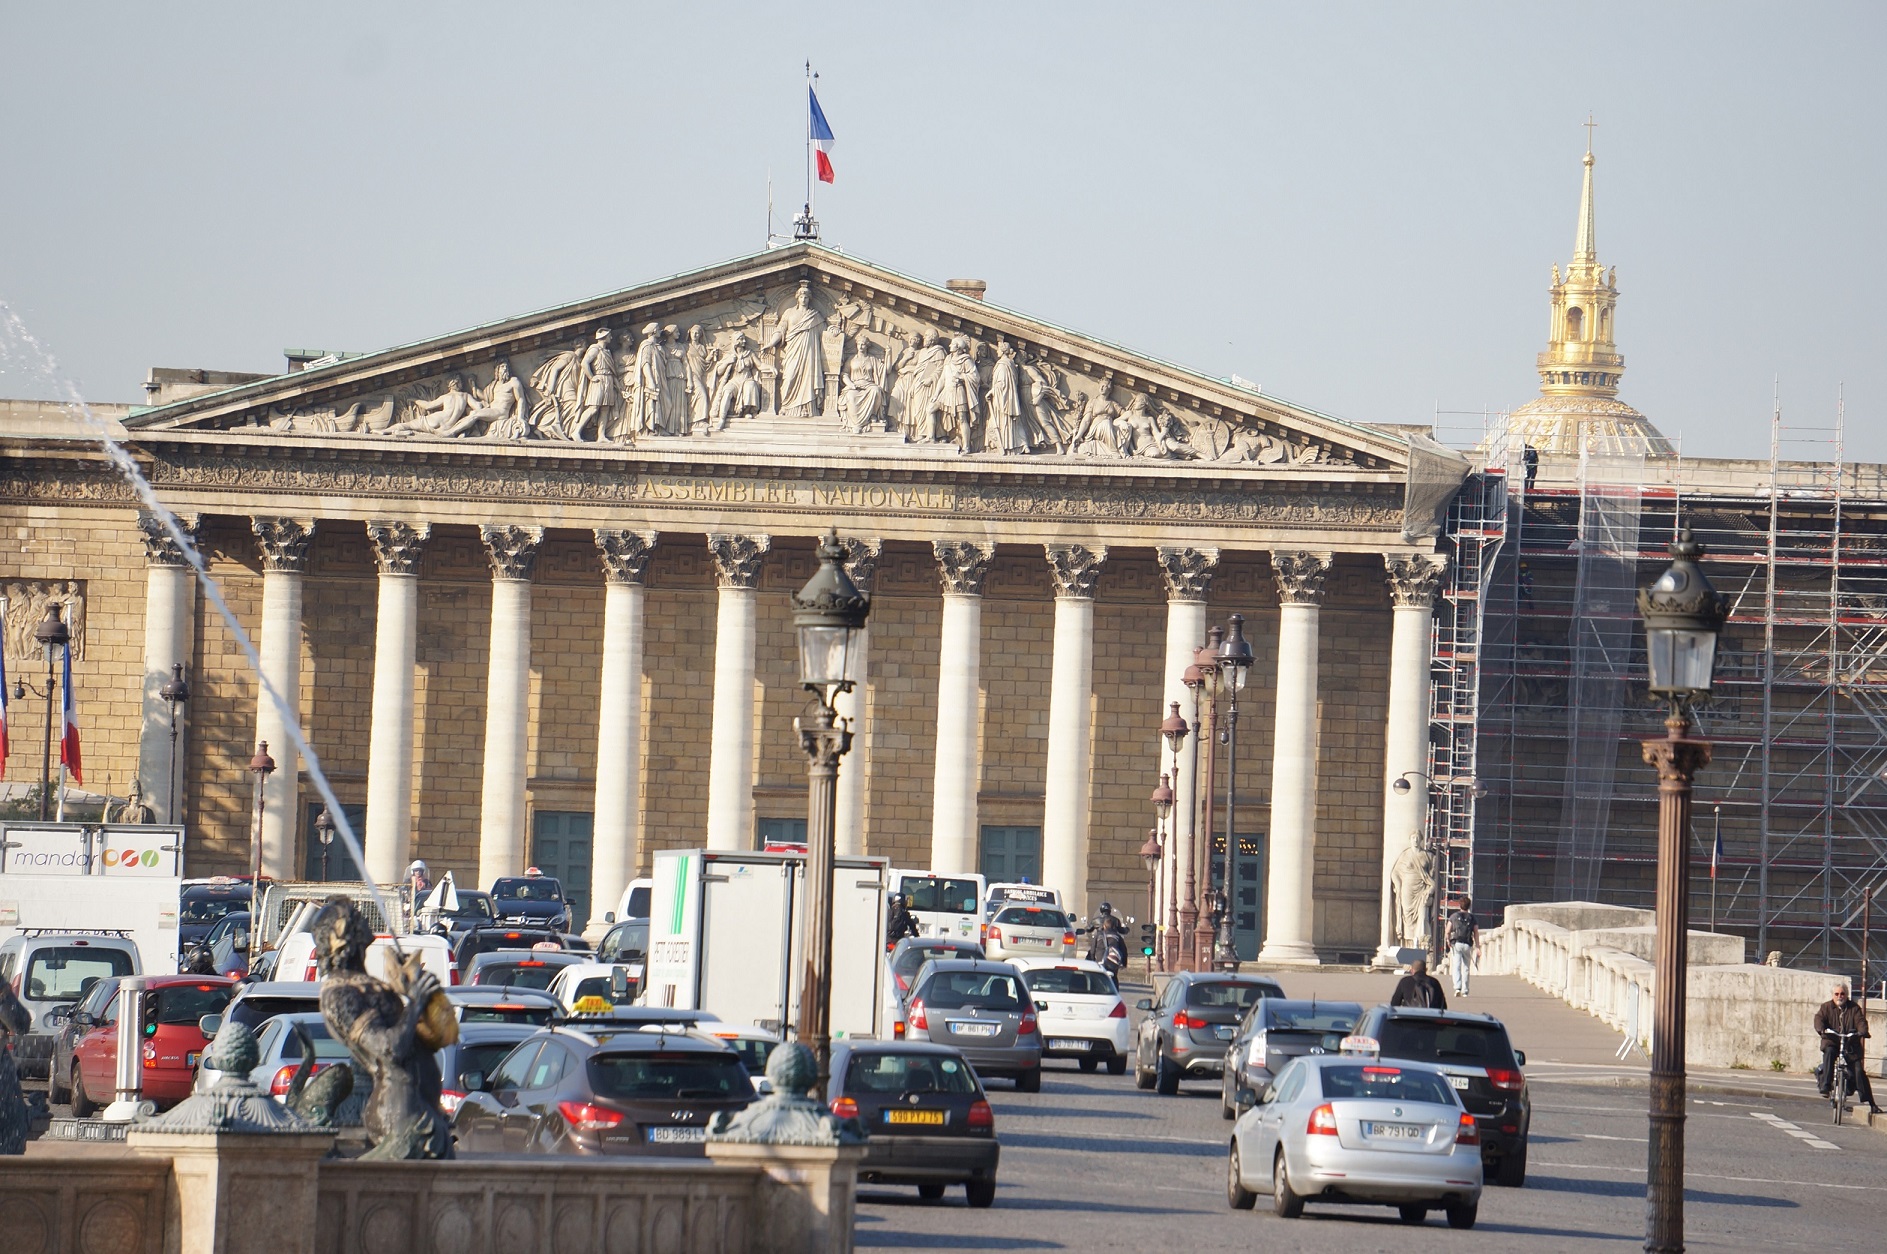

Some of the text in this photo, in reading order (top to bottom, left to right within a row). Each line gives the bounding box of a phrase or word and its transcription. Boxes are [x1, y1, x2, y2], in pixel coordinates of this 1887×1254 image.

[641, 478, 953, 510] ASSEMBLÉE NATIONALE
[585, 998, 603, 1006] TAXI
[892, 1110, 939, 1123] 590 PYJ 75
[656, 1127, 669, 1140] BD
[672, 1127, 692, 1140] 989
[1373, 1125, 1385, 1135] BR
[1388, 1126, 1405, 1138] 791
